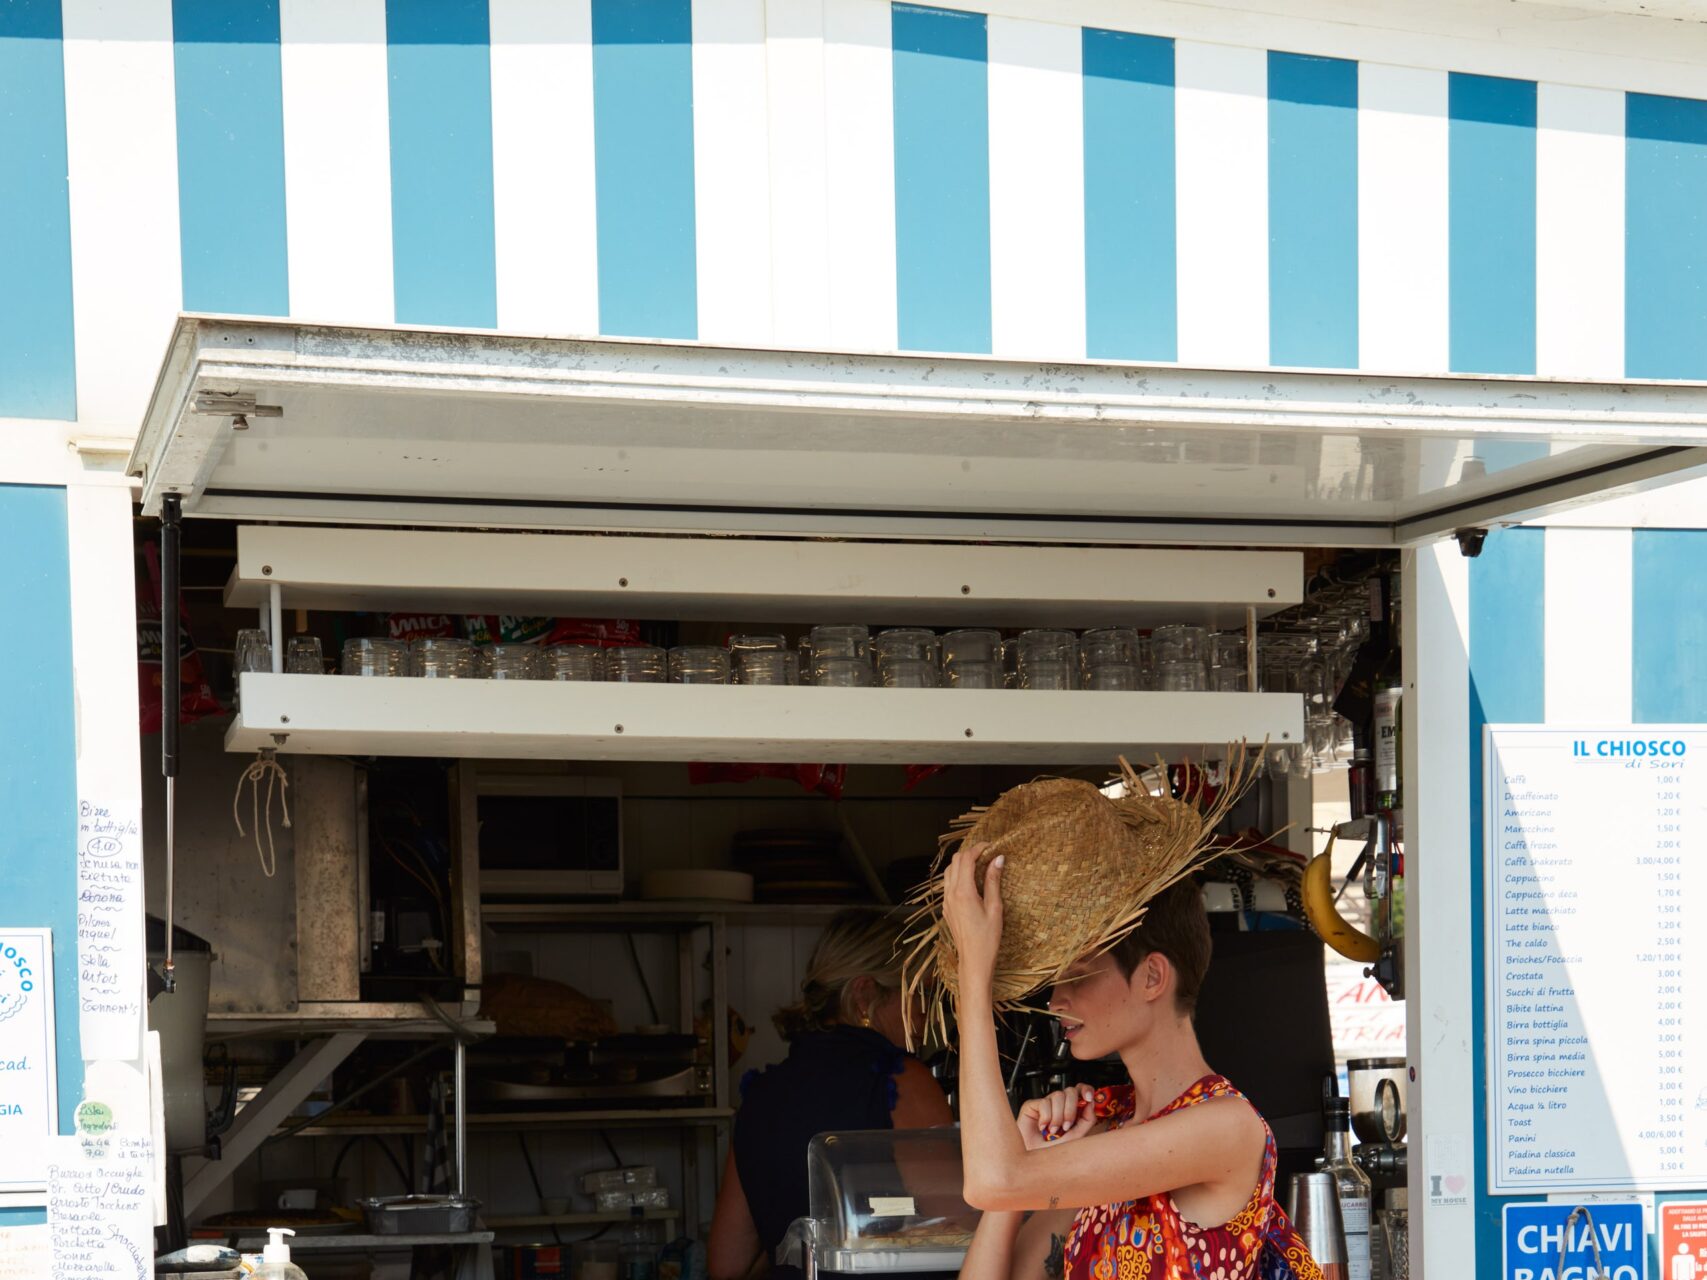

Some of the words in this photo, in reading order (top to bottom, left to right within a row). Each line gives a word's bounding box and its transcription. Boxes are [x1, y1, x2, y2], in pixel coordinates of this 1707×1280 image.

[1574, 741, 1590, 756] IL
[1597, 741, 1686, 756] CHIOSCO
[1625, 758, 1642, 768] di
[1649, 759, 1685, 768] Sori
[1505, 809, 1551, 817] Americano
[1505, 825, 1555, 833] Marocchino
[1505, 874, 1555, 884] Cappuccino
[1505, 891, 1555, 901] Cappuccino
[1506, 923, 1529, 931] Latte
[1532, 923, 1559, 931] bianco
[1525, 939, 1548, 947] caldo
[1506, 972, 1543, 980] Crostata
[1506, 988, 1534, 996] Succhi
[1537, 988, 1545, 996] di
[1549, 988, 1574, 996] frutta
[1507, 1004, 1531, 1013] Bibite
[1535, 1004, 1563, 1012] lattina
[1507, 1021, 1529, 1029] Birra
[1533, 1020, 1568, 1031] bottiglia
[1507, 1037, 1529, 1045] Birra
[1533, 1037, 1555, 1047] spina
[1559, 1036, 1588, 1046] piccola
[1507, 1054, 1530, 1062] Birra
[1533, 1053, 1555, 1064] spina
[1559, 1053, 1585, 1061] media
[1508, 1070, 1544, 1078] Prosecco
[1548, 1069, 1585, 1077] bicchiere
[1508, 1086, 1526, 1094] Vino
[1531, 1085, 1568, 1093] bicchiere
[1508, 1103, 1534, 1111] Acqua
[1548, 1101, 1566, 1110] litro
[1509, 1151, 1541, 1159] Piadina
[1545, 1150, 1575, 1158] classica
[1509, 1167, 1541, 1175] Piadina
[1545, 1166, 1574, 1174] nutella
[1517, 1223, 1633, 1254] CHIAVI
